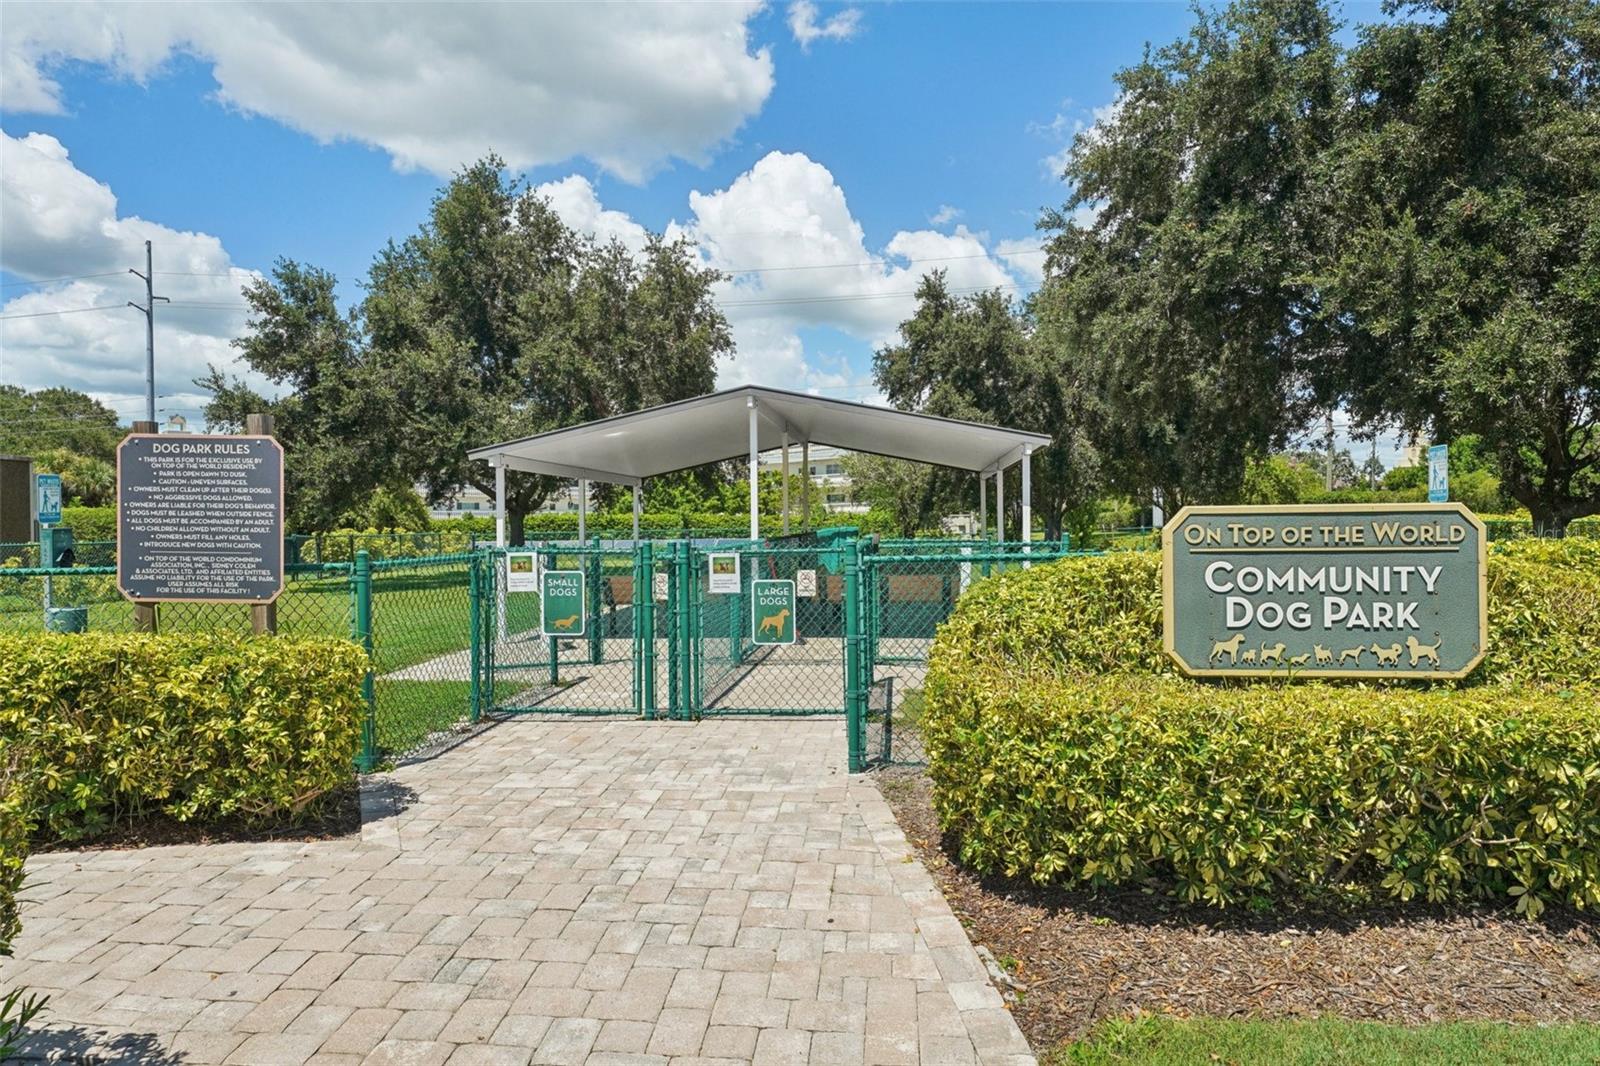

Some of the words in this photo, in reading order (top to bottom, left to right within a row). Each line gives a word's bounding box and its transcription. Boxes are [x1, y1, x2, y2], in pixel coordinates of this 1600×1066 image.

[153, 444, 180, 454] DOG
[182, 444, 213, 454] PARK
[214, 444, 250, 454] RULES
[1184, 524, 1221, 544] ON
[1228, 524, 1274, 544] TOP
[1281, 525, 1312, 544] OF
[1321, 526, 1364, 544] THE
[1372, 522, 1466, 543] WORLD
[1204, 561, 1443, 593] COMMUNITY
[548, 578, 578, 587] SMALL
[550, 588, 577, 596] DOGS
[758, 587, 789, 596] LARGE
[760, 596, 788, 605] DOGS
[1226, 596, 1312, 629] DOG
[1324, 597, 1420, 629] PARK
